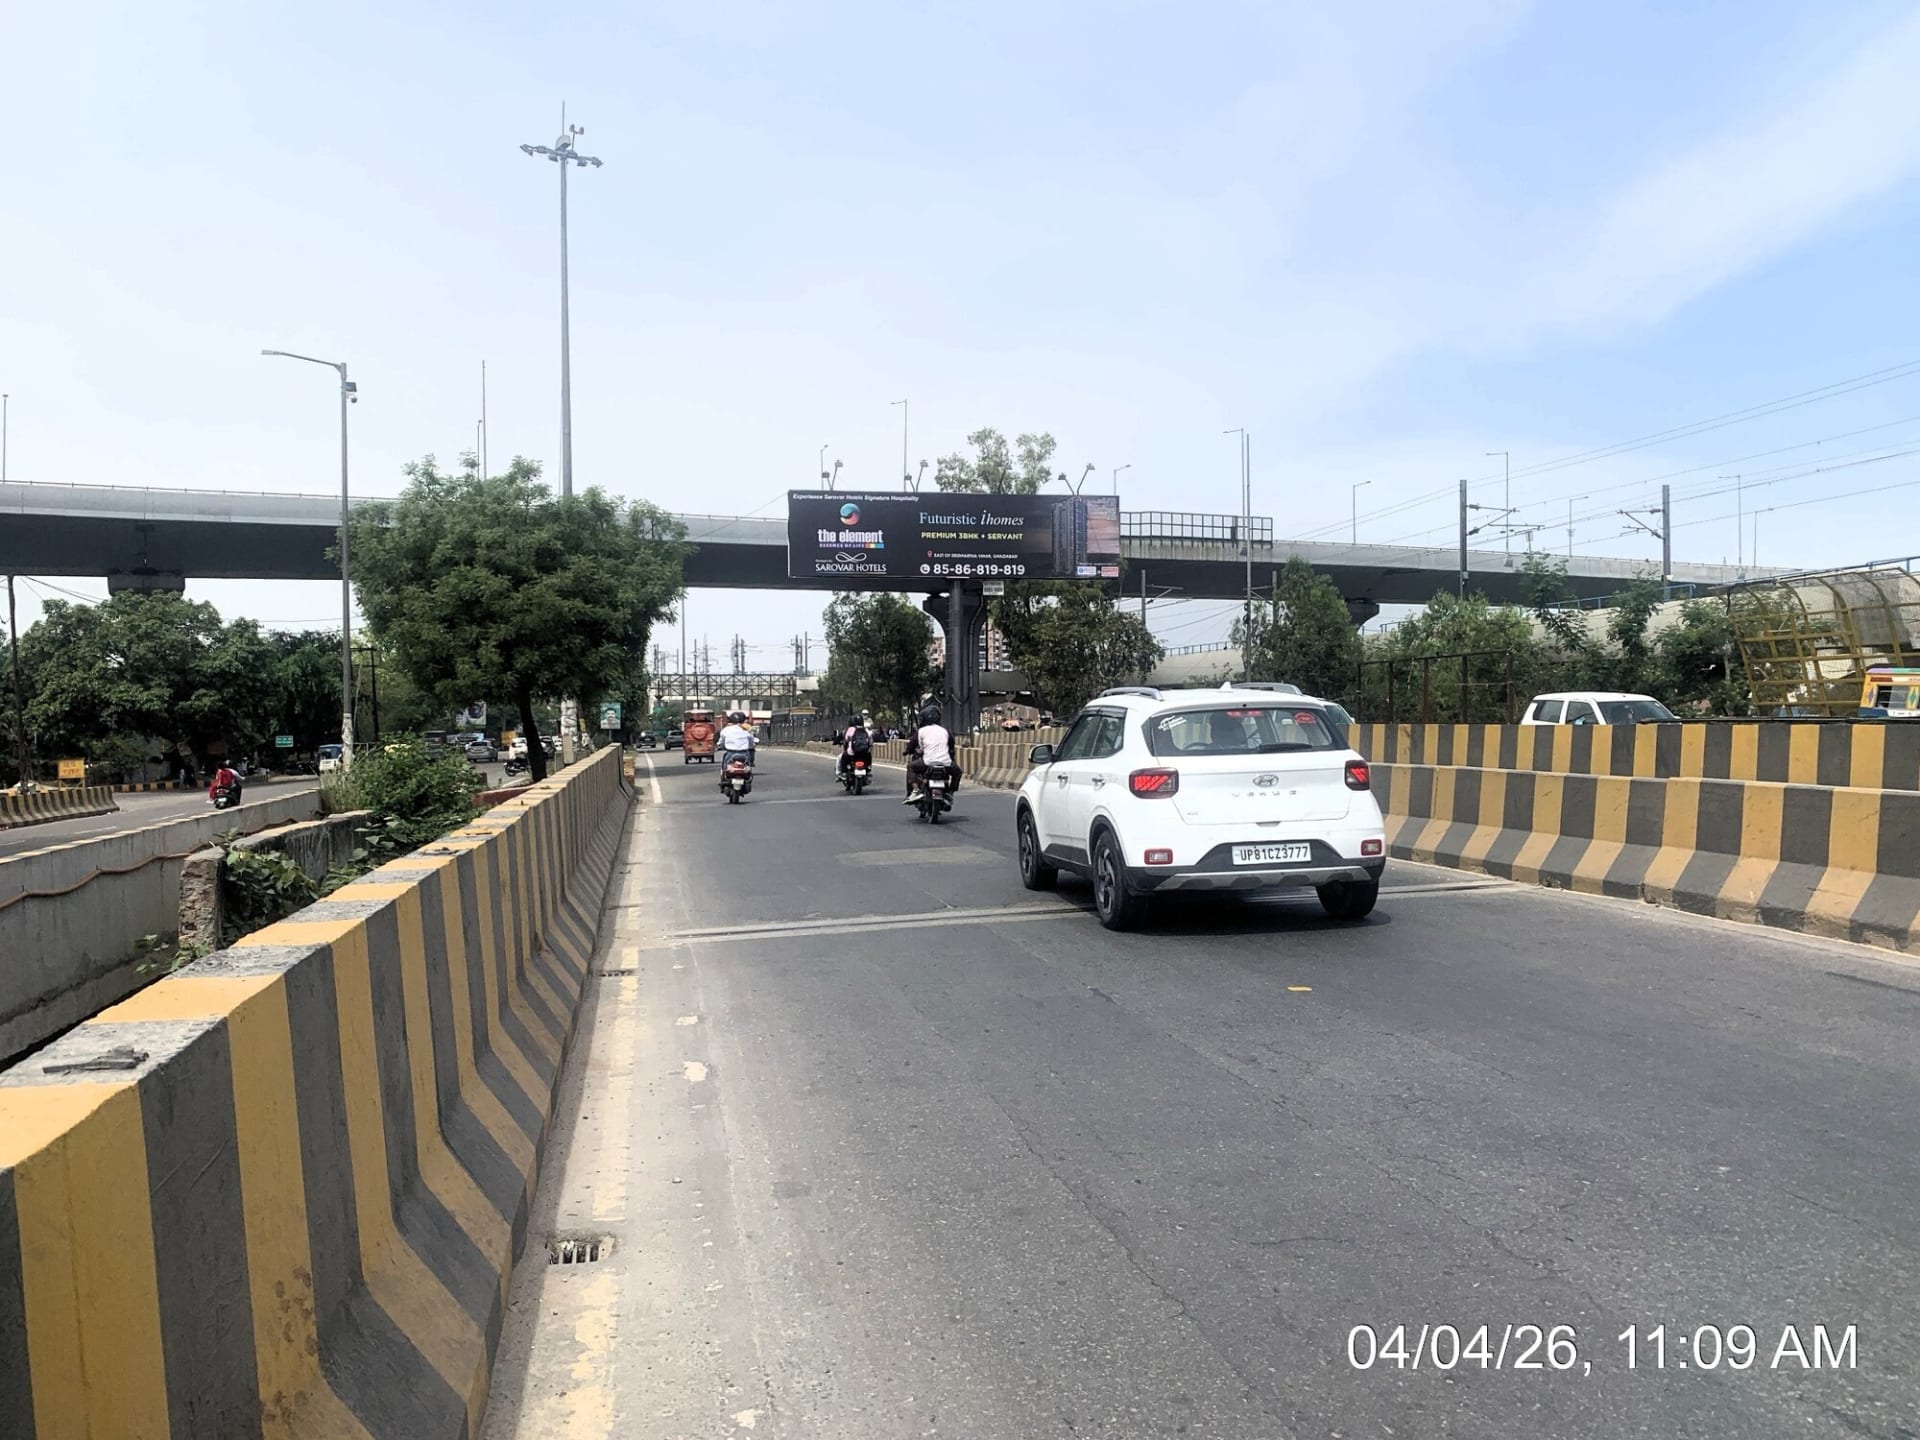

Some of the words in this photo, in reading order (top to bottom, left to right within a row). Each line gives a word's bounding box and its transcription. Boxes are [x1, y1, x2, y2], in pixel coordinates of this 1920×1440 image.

[919, 512, 976, 525] Futuristic
[817, 528, 837, 543] the
[839, 529, 883, 543] element
[921, 531, 956, 539] PREMIUM
[815, 563, 855, 572] SAROVAR
[856, 563, 886, 572] HOTELS
[933, 563, 1025, 576] 85-86-819-819
[1239, 846, 1308, 861] UP81CZ3777
